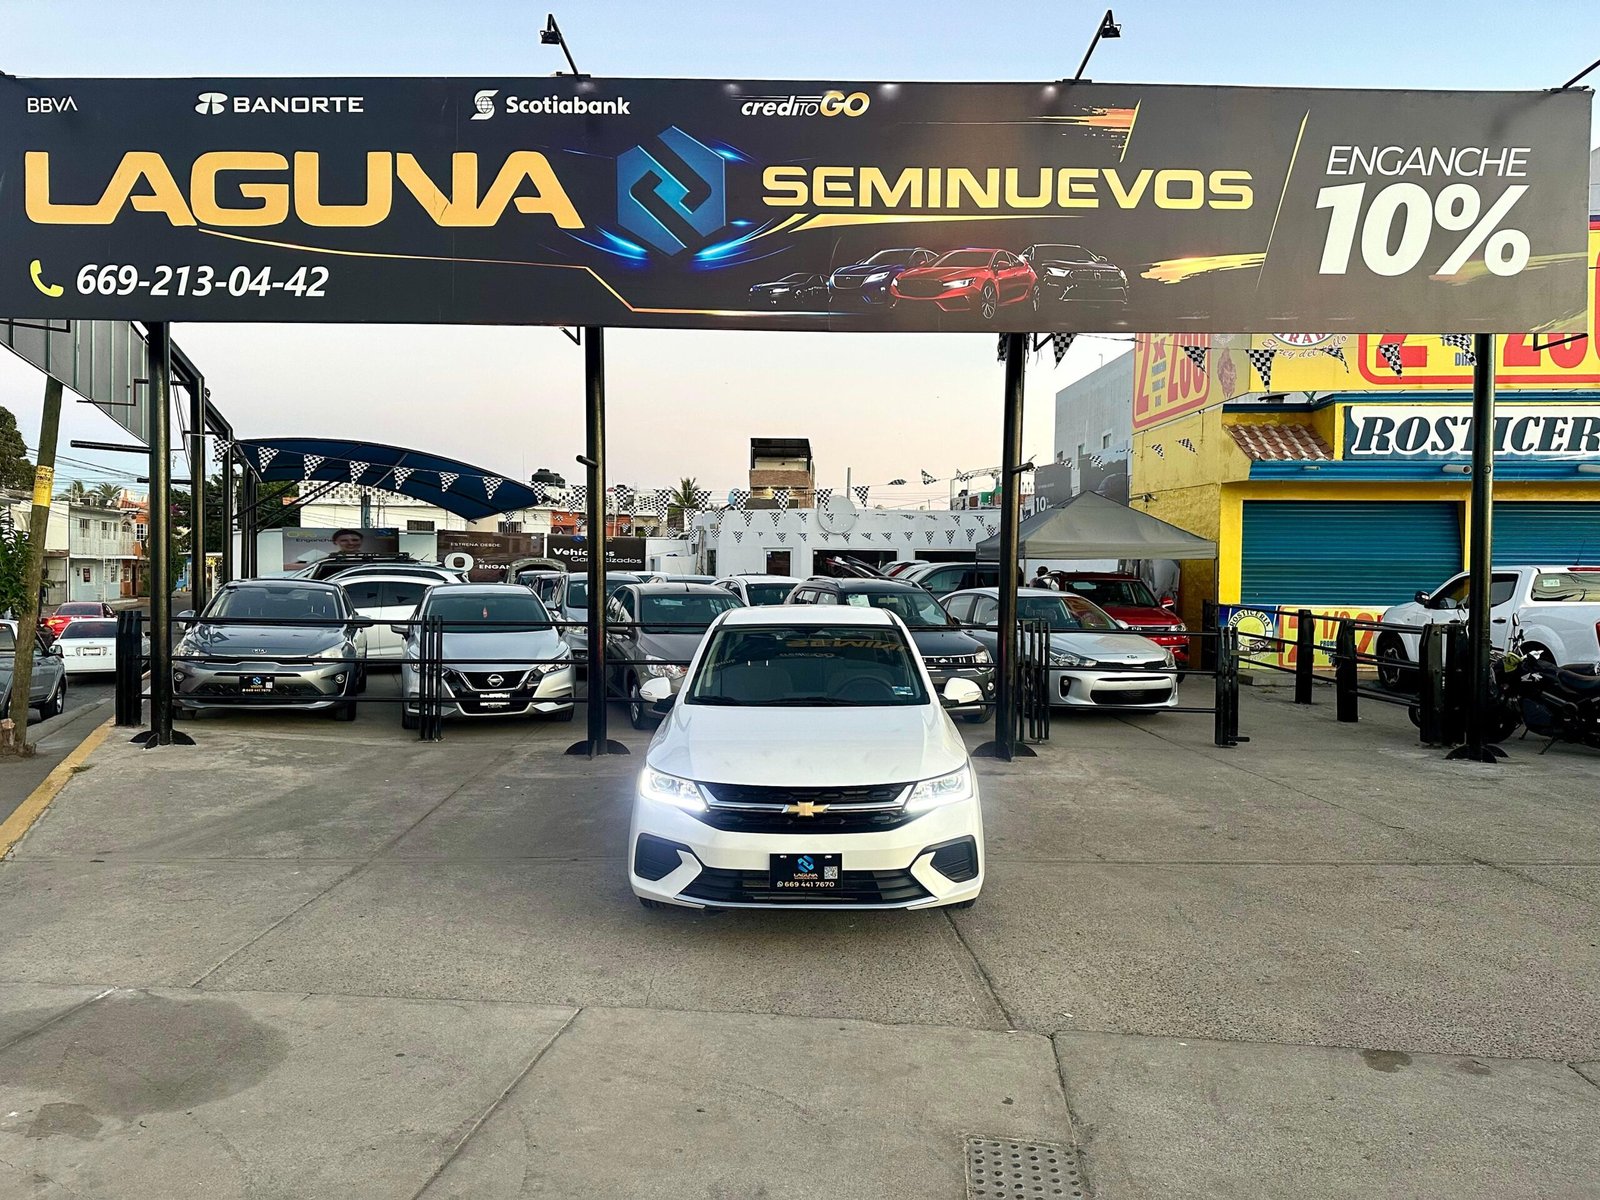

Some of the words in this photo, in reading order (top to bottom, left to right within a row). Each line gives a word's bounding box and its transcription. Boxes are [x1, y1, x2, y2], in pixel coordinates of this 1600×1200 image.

[26, 96, 78, 113] BBVA
[234, 96, 364, 114] BANORTE
[506, 95, 631, 116] Scotiabank
[1326, 146, 1532, 177] ENGANCHE
[24, 151, 585, 229] LAGUNA
[762, 166, 1254, 209] SEMINUEVOS
[1315, 182, 1531, 277] 10%
[75, 263, 330, 297] 669-213-04-42
